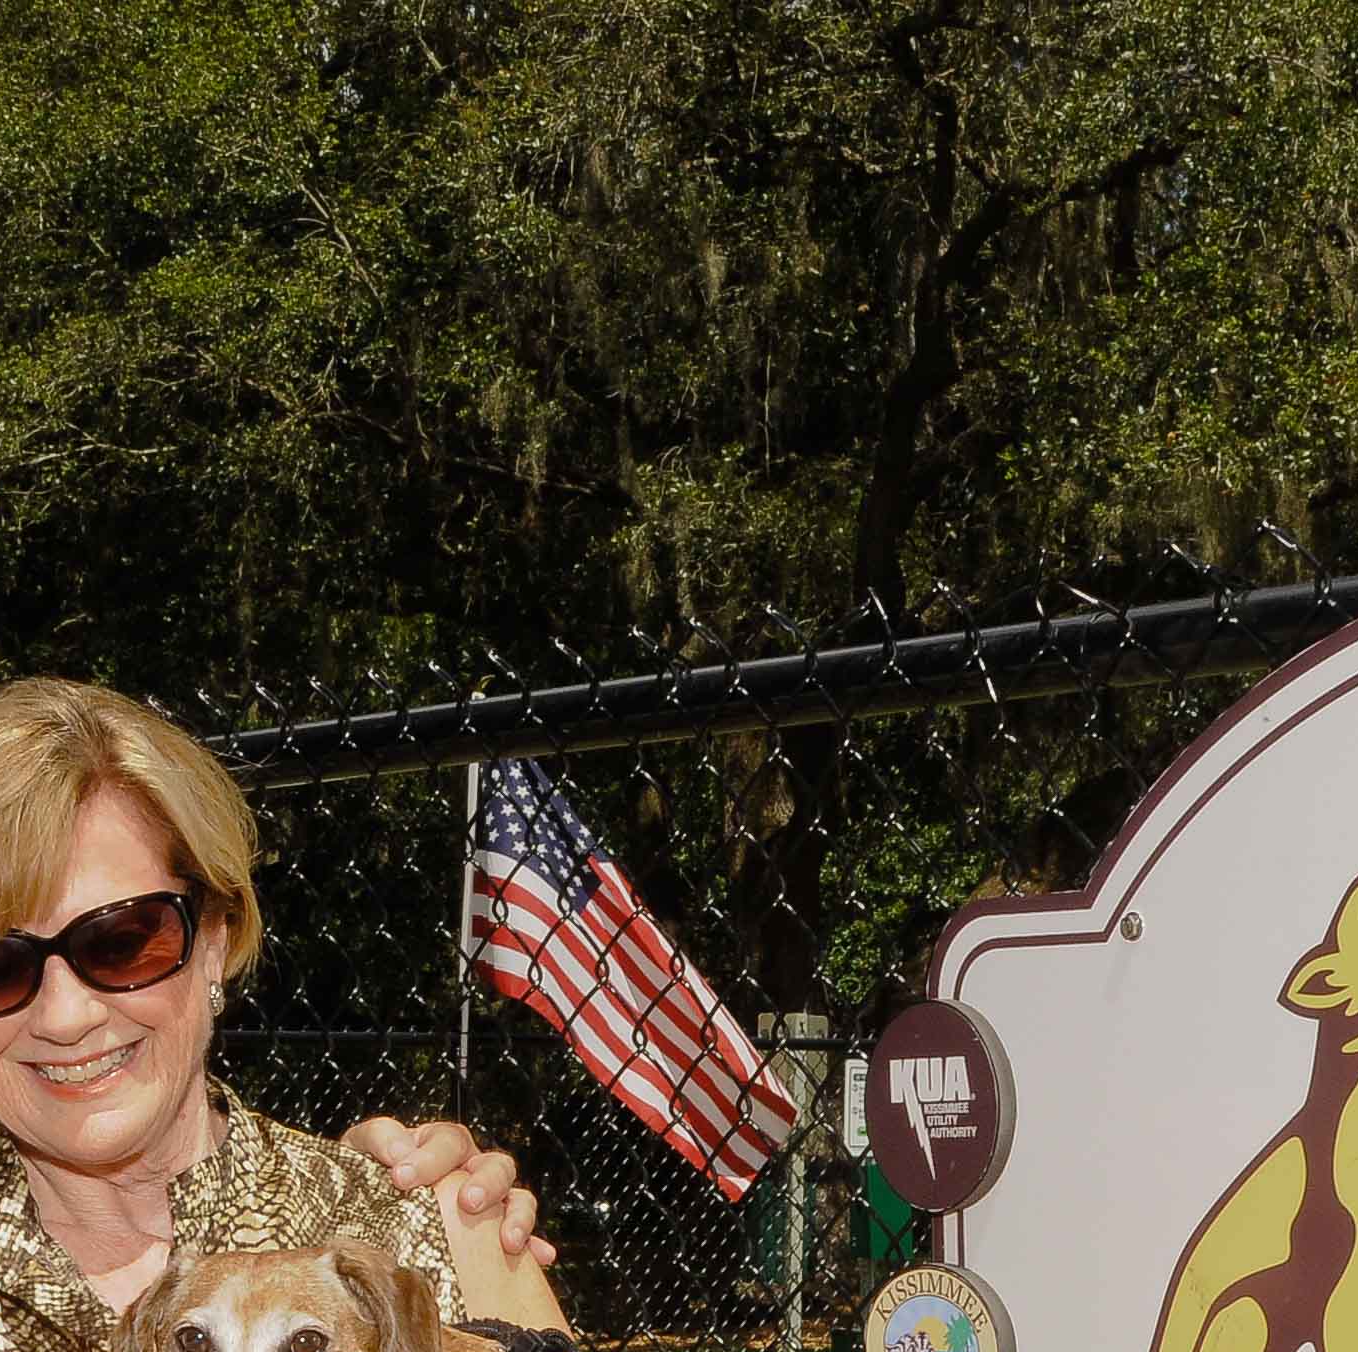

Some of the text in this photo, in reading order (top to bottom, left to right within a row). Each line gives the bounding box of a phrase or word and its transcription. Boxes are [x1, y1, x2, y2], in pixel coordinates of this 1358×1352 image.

[926, 1115, 959, 1127] UTILITY
[929, 1126, 978, 1139] AUTHORITY
[875, 1271, 989, 1334] KISSIMMEE
